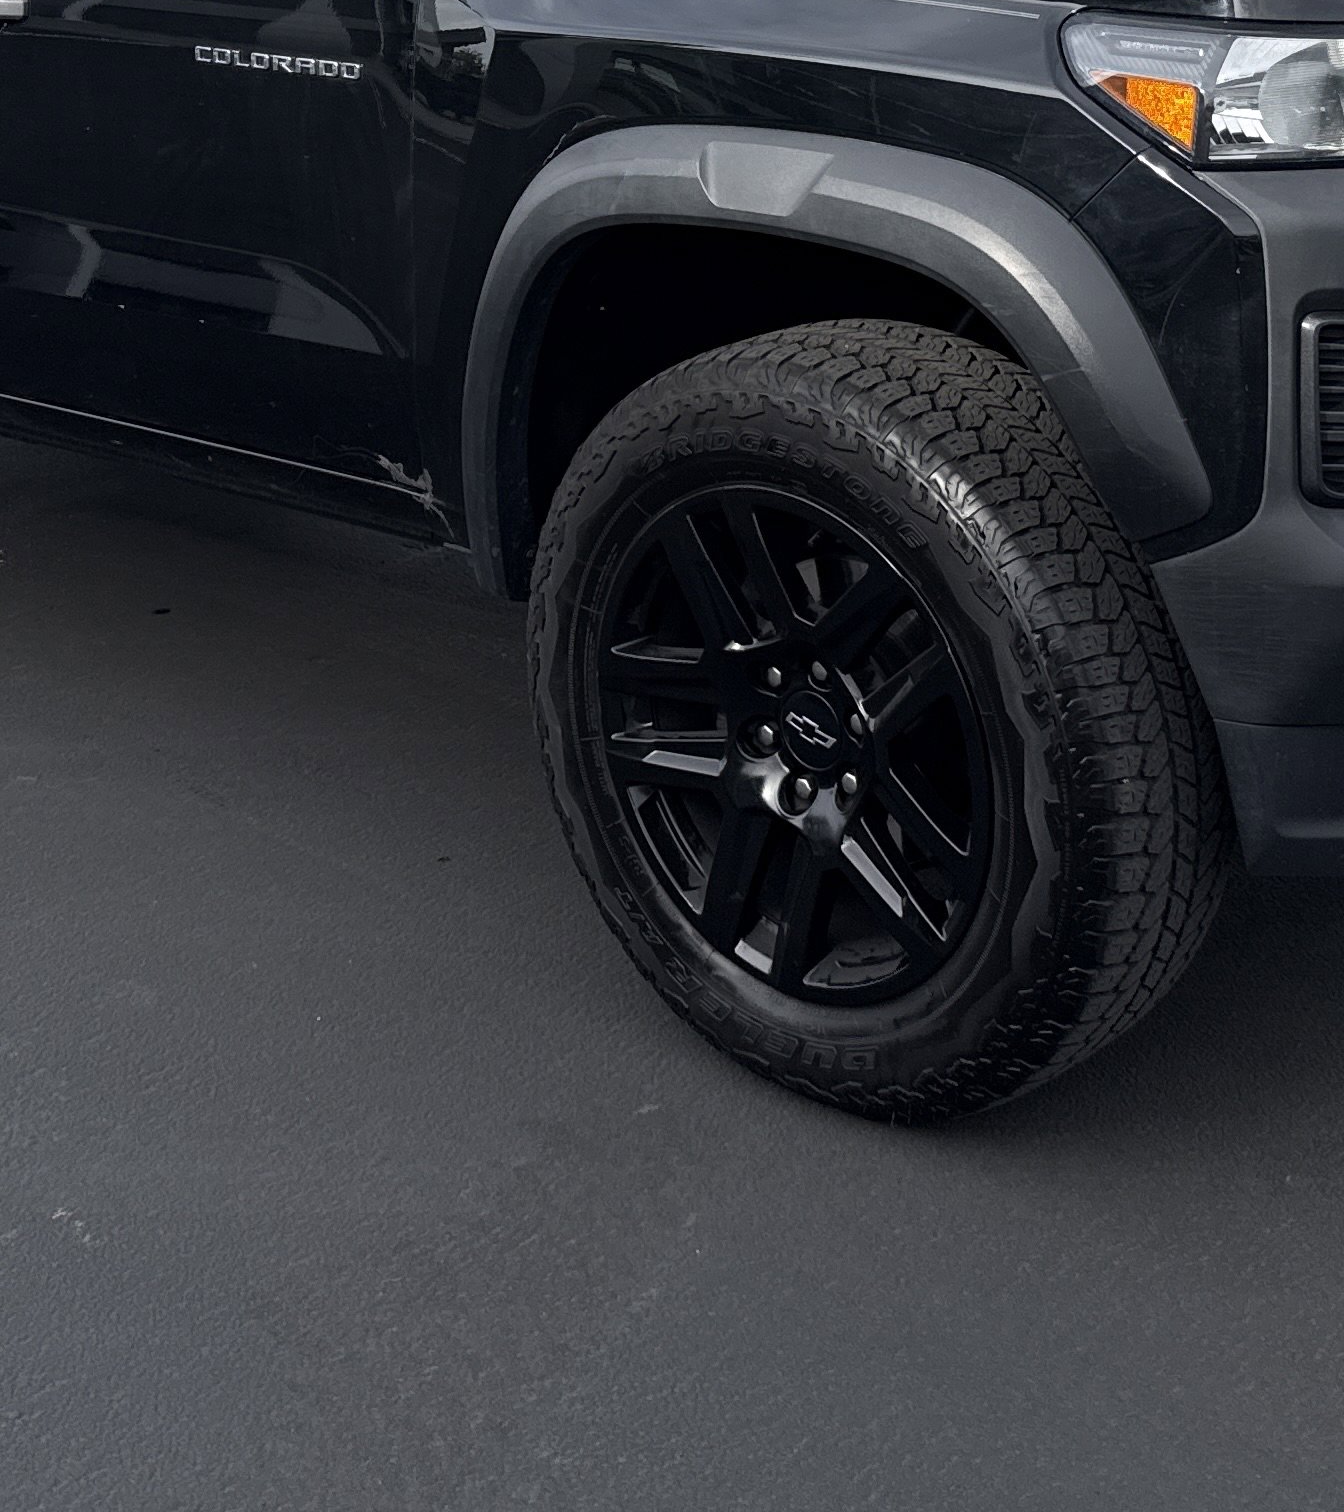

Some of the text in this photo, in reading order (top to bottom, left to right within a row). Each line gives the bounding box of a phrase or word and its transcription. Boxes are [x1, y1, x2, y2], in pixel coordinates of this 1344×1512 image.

[194, 45, 363, 80] COLORADO
[640, 426, 929, 549] BRIDGESTONE
[662, 956, 879, 1070] DUELER
